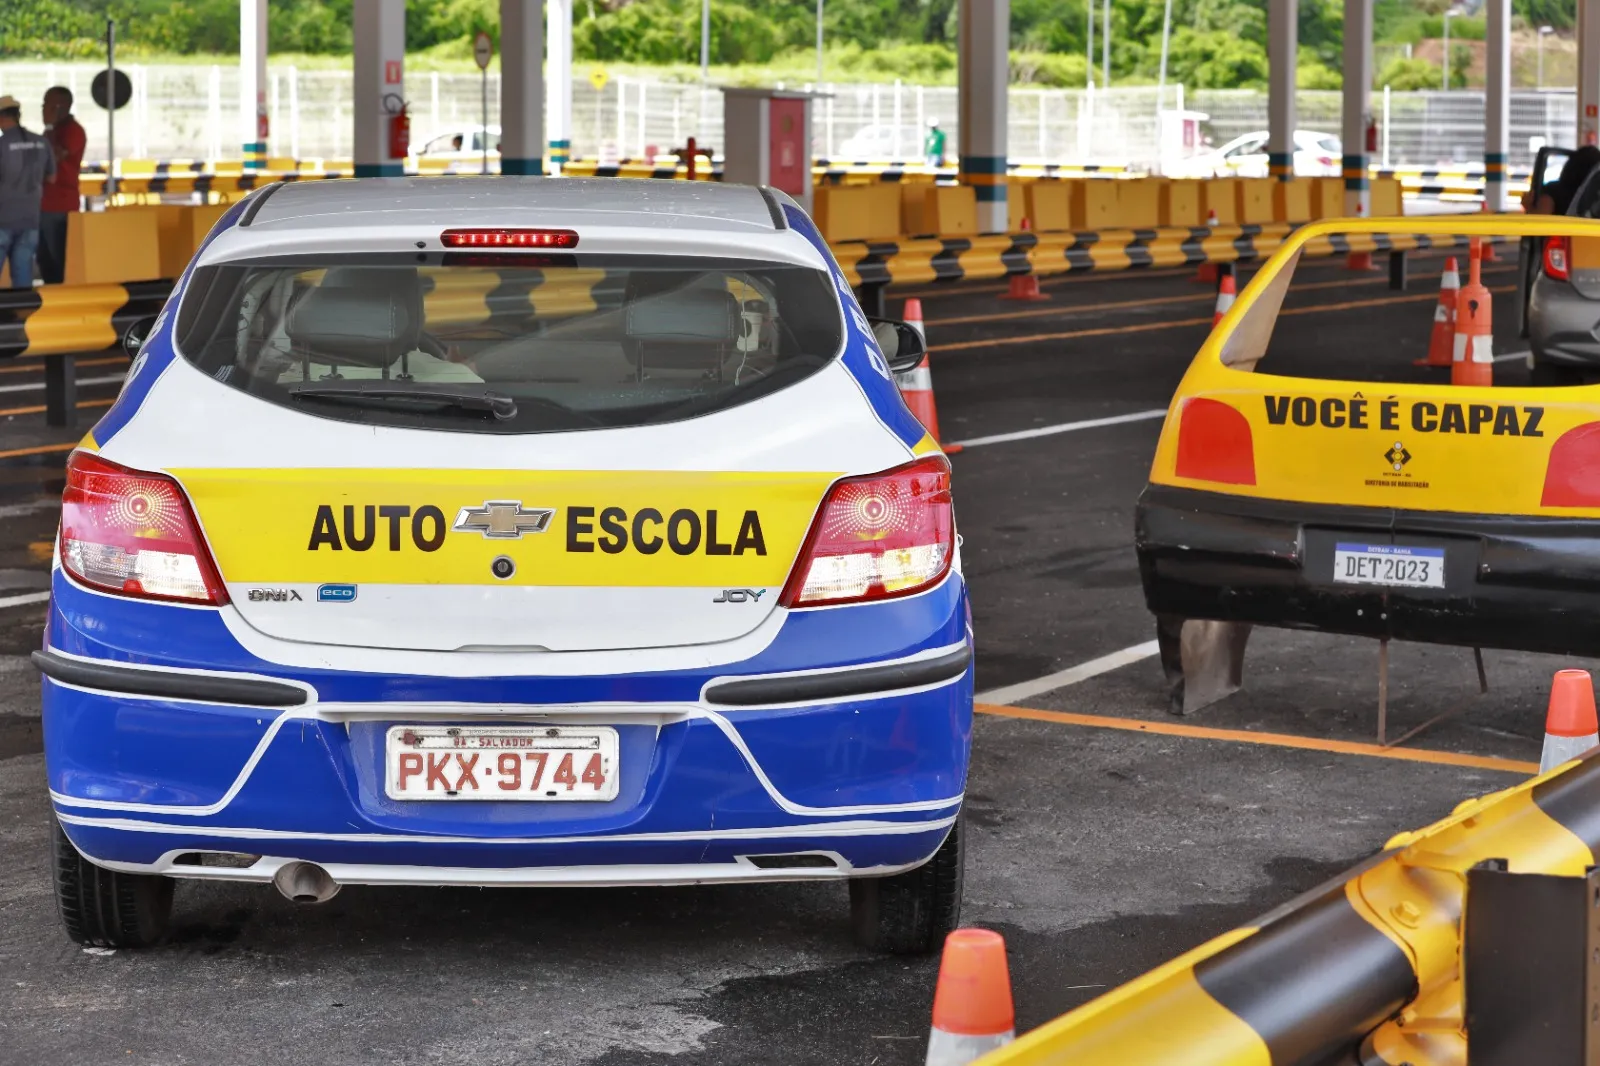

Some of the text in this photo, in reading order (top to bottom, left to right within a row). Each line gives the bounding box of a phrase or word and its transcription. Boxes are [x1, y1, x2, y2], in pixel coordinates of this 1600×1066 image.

[1264, 391, 1544, 437] VOCÊ É CAPAZ
[308, 505, 767, 556] AUTO ESCOLA
[1345, 556, 1430, 582] DET2023
[322, 589, 353, 597] eco
[713, 588, 766, 603] JOY
[479, 736, 534, 748] SALVADOR
